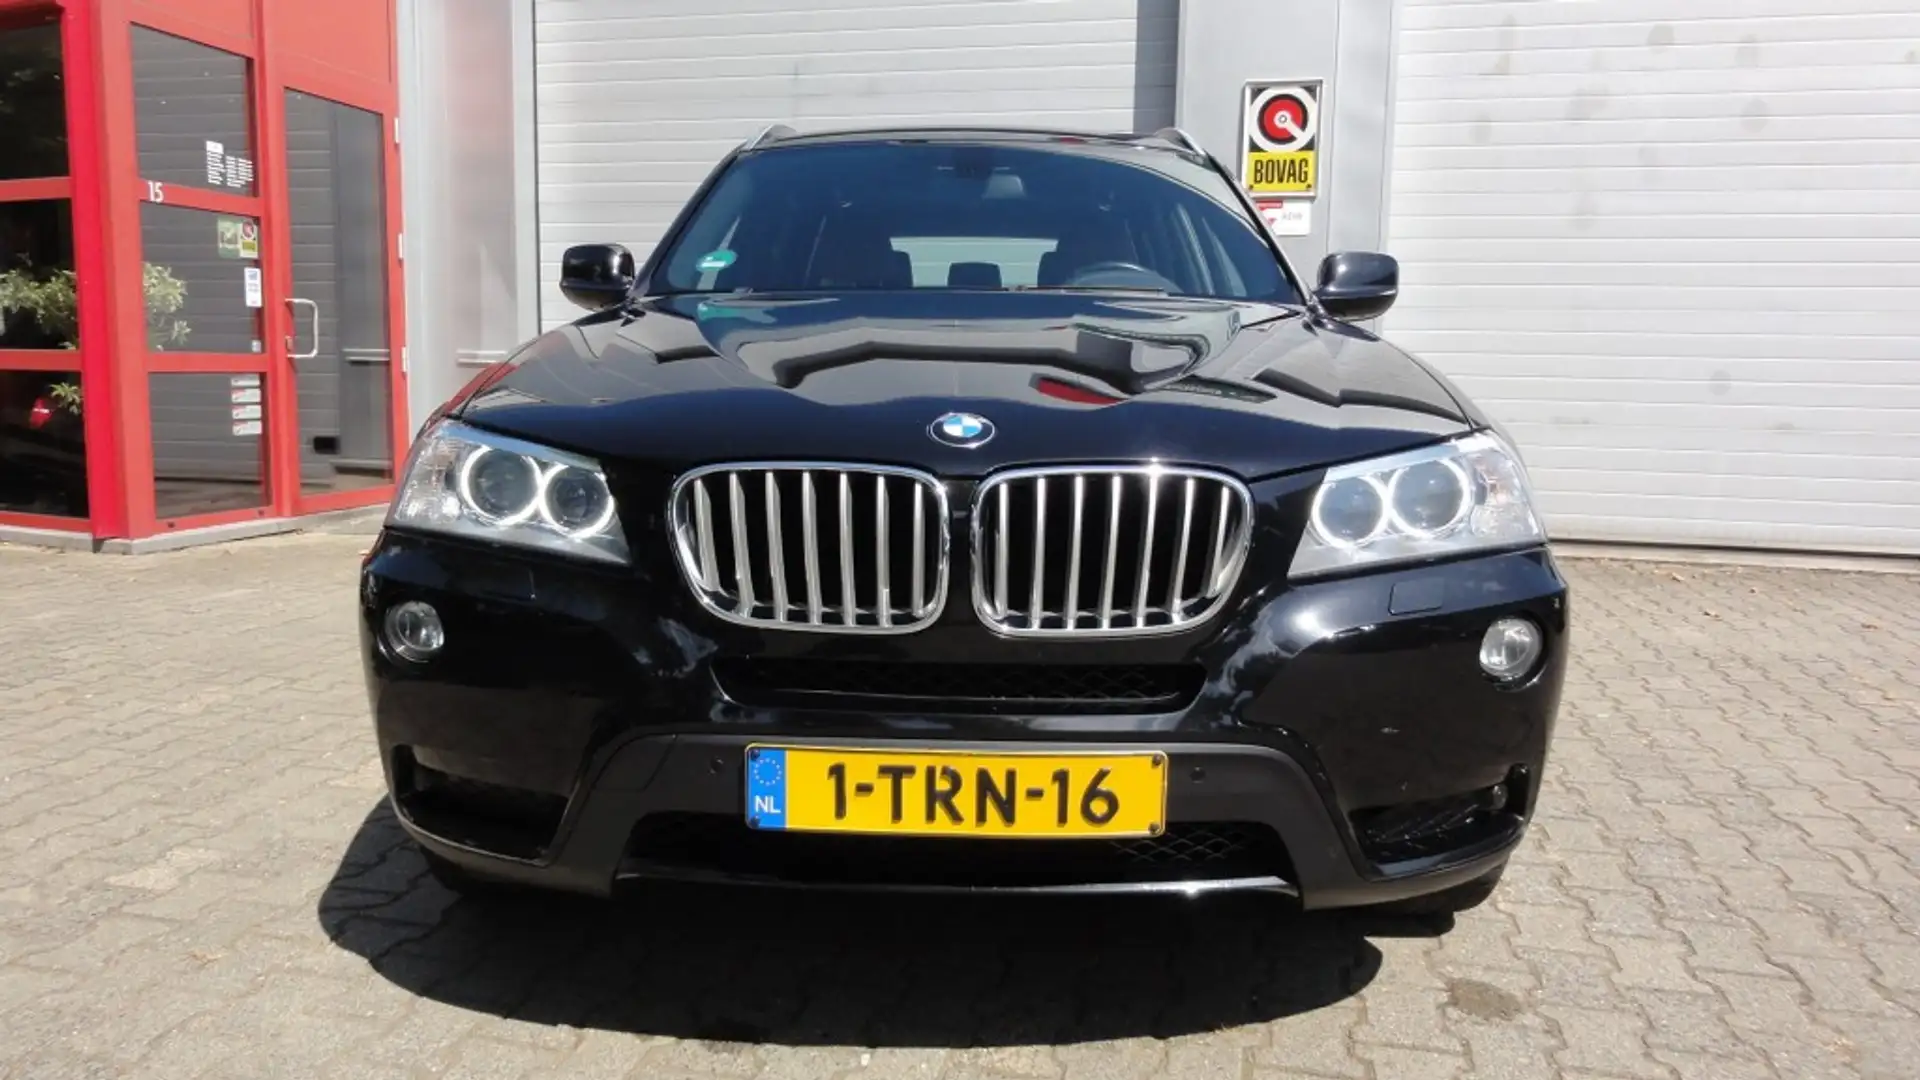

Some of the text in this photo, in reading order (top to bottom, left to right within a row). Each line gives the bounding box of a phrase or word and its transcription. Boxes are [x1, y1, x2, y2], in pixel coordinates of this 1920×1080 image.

[1254, 158, 1309, 184] BOVAG
[148, 180, 164, 204] 15
[754, 795, 782, 814] NL
[827, 762, 1120, 828] 1-TRN-16
